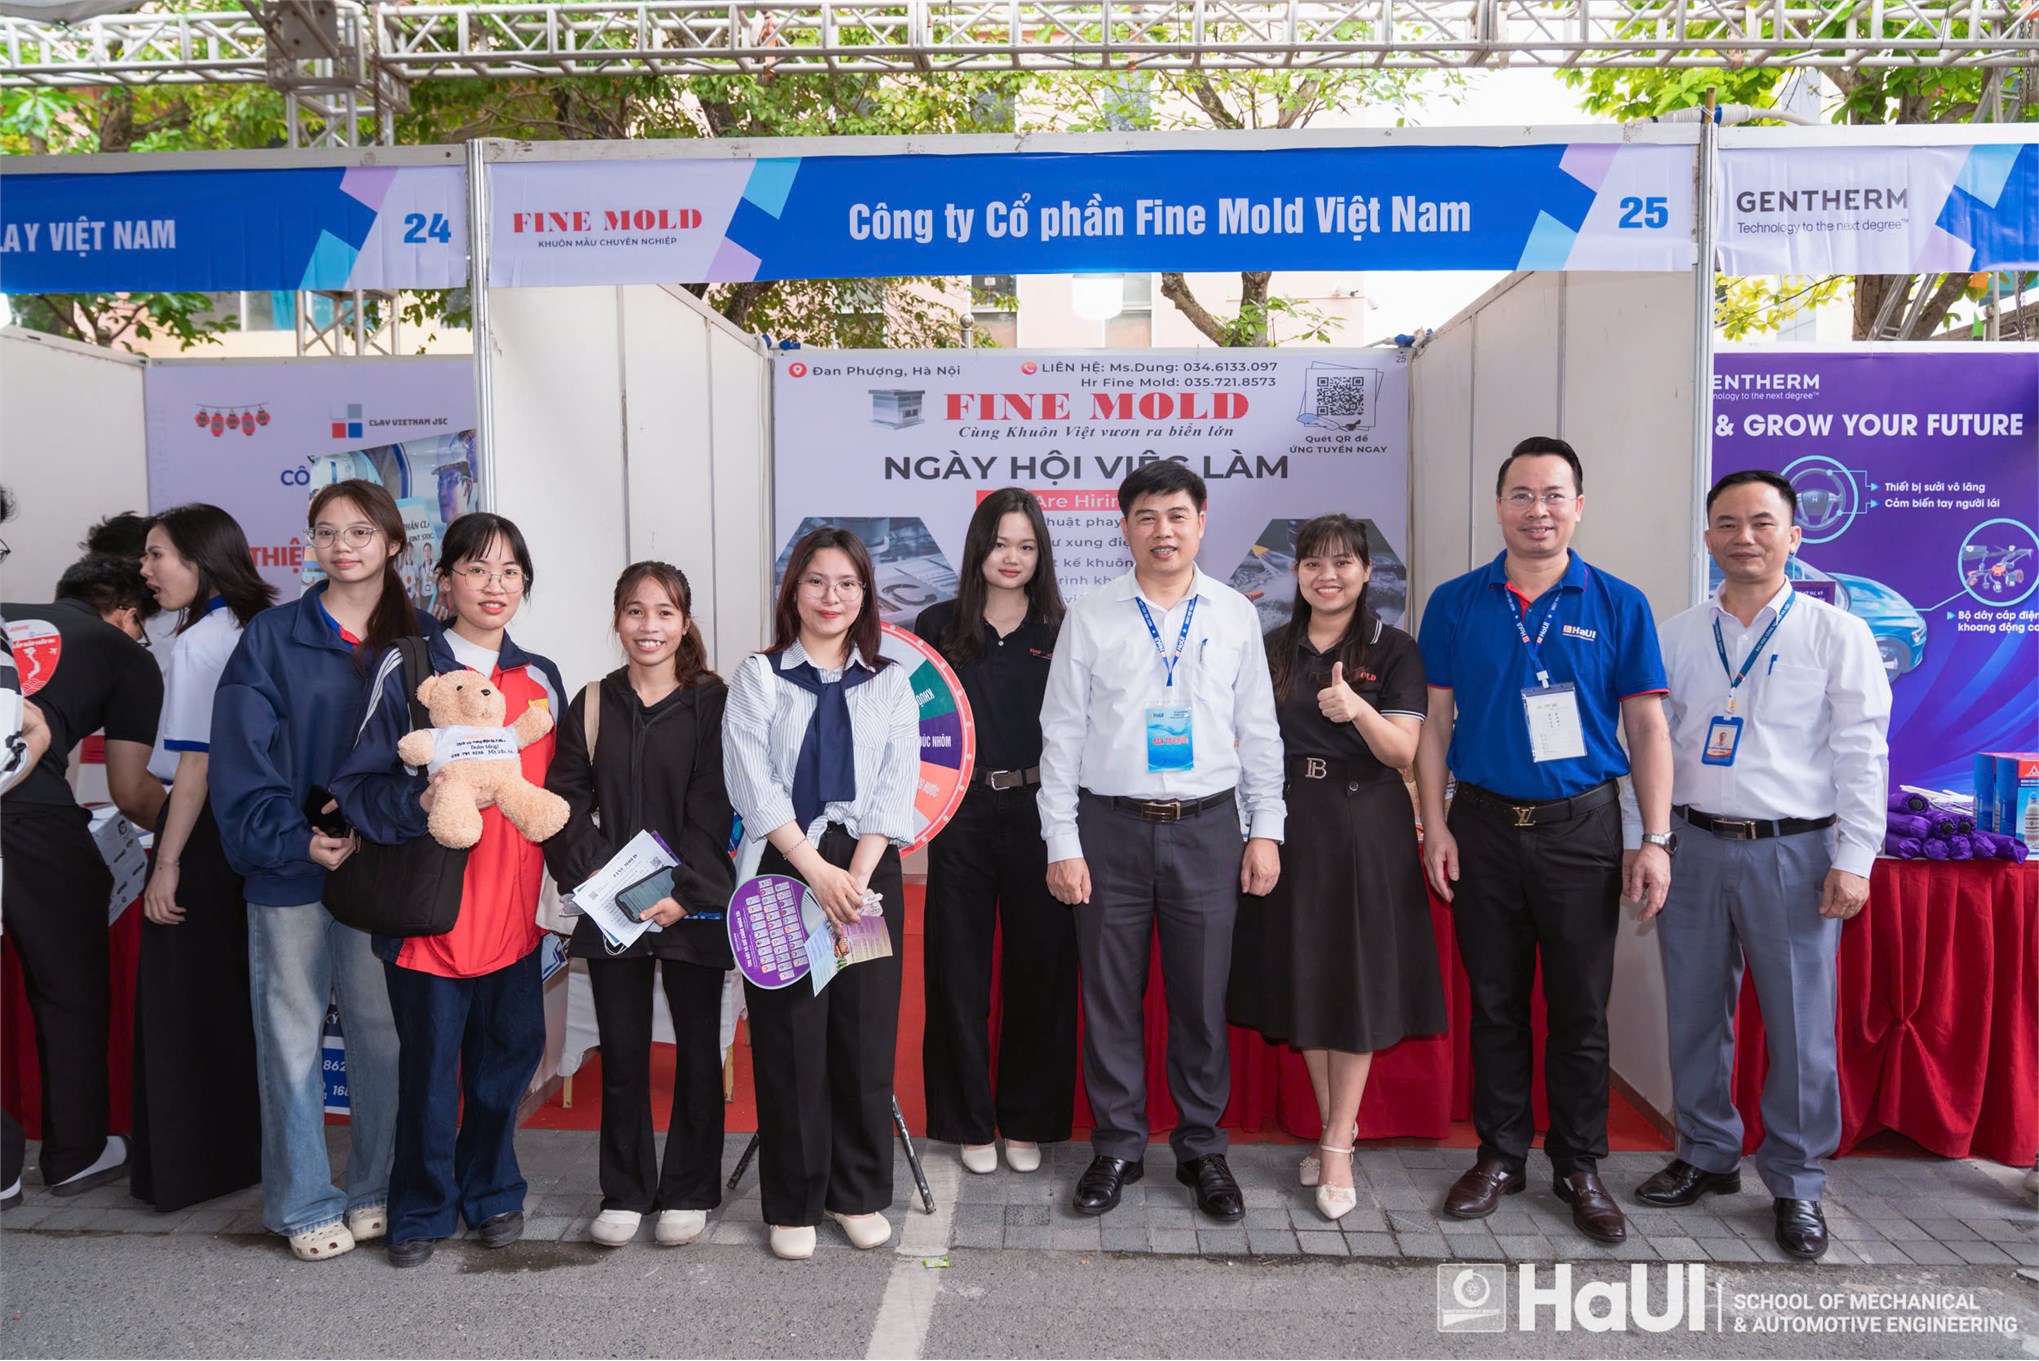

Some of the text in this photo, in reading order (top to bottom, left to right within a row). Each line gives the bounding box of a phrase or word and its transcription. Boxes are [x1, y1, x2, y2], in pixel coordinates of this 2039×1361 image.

[1736, 188, 1908, 213] GENTHERM
[849, 192, 1471, 244] Công ty Cổ phần Fine Mold Việt Nam
[1618, 196, 1669, 229] 25
[513, 208, 703, 233] FINE MOLD
[403, 212, 452, 244] 24
[1737, 221, 1800, 235] Technology
[1802, 221, 1814, 232] to
[1815, 220, 1834, 232] the
[1836, 220, 1860, 231] next
[49, 216, 105, 258] VIỆT
[113, 219, 176, 250] NAM
[538, 237, 574, 248] KHUÔN
[599, 236, 639, 247] CHUYÊN
[641, 235, 677, 247] NGHIỆP
[1396, 355, 1407, 364] 25
[812, 365, 961, 378] Đan Phượng, Hà Nội
[1042, 361, 1278, 375] LIÊN HỆ: Ms.Dung: 034.6133.097
[1081, 377, 1276, 387] Hr Fine Mold: 035.721.8573
[1712, 374, 1820, 390] ENTHERM
[1712, 391, 1740, 402] nology
[1741, 392, 1750, 400] to
[1751, 391, 1765, 400] the
[1766, 391, 1784, 400] next
[943, 392, 1249, 421] FINE MOLD
[369, 417, 448, 427] CLAY VIETNAM JSC
[1715, 413, 2023, 437] & GROW YOUR FUTURE
[958, 422, 1234, 440] Cùng Khuôn Việt vươn ra biển lớn
[1305, 435, 1332, 444] Quét
[1335, 435, 1352, 444] QR
[1356, 446, 1388, 454] NGAY
[884, 450, 999, 480] NGÀY
[1009, 449, 1081, 486] HỘI
[1203, 449, 1289, 479] LÀM
[280, 465, 310, 486] CÔ
[1884, 482, 1909, 492] Thiết
[1912, 482, 1922, 493] bị
[1884, 497, 2000, 510] Cảm biến tay người lái
[1046, 517, 1120, 528] huật phay
[1066, 538, 1103, 549] xung
[249, 537, 305, 575] THIỆ
[1064, 557, 1081, 568] kế
[1086, 557, 1134, 568] khuôn
[1058, 575, 1088, 585] rình
[1957, 610, 1971, 622] Bộ
[1973, 610, 1994, 622] dây
[1995, 610, 2016, 622] cáp
[1572, 626, 1597, 639] HaUI
[1957, 622, 1997, 634] khoang
[1998, 622, 2020, 634] động
[932, 733, 951, 748] NHÔM
